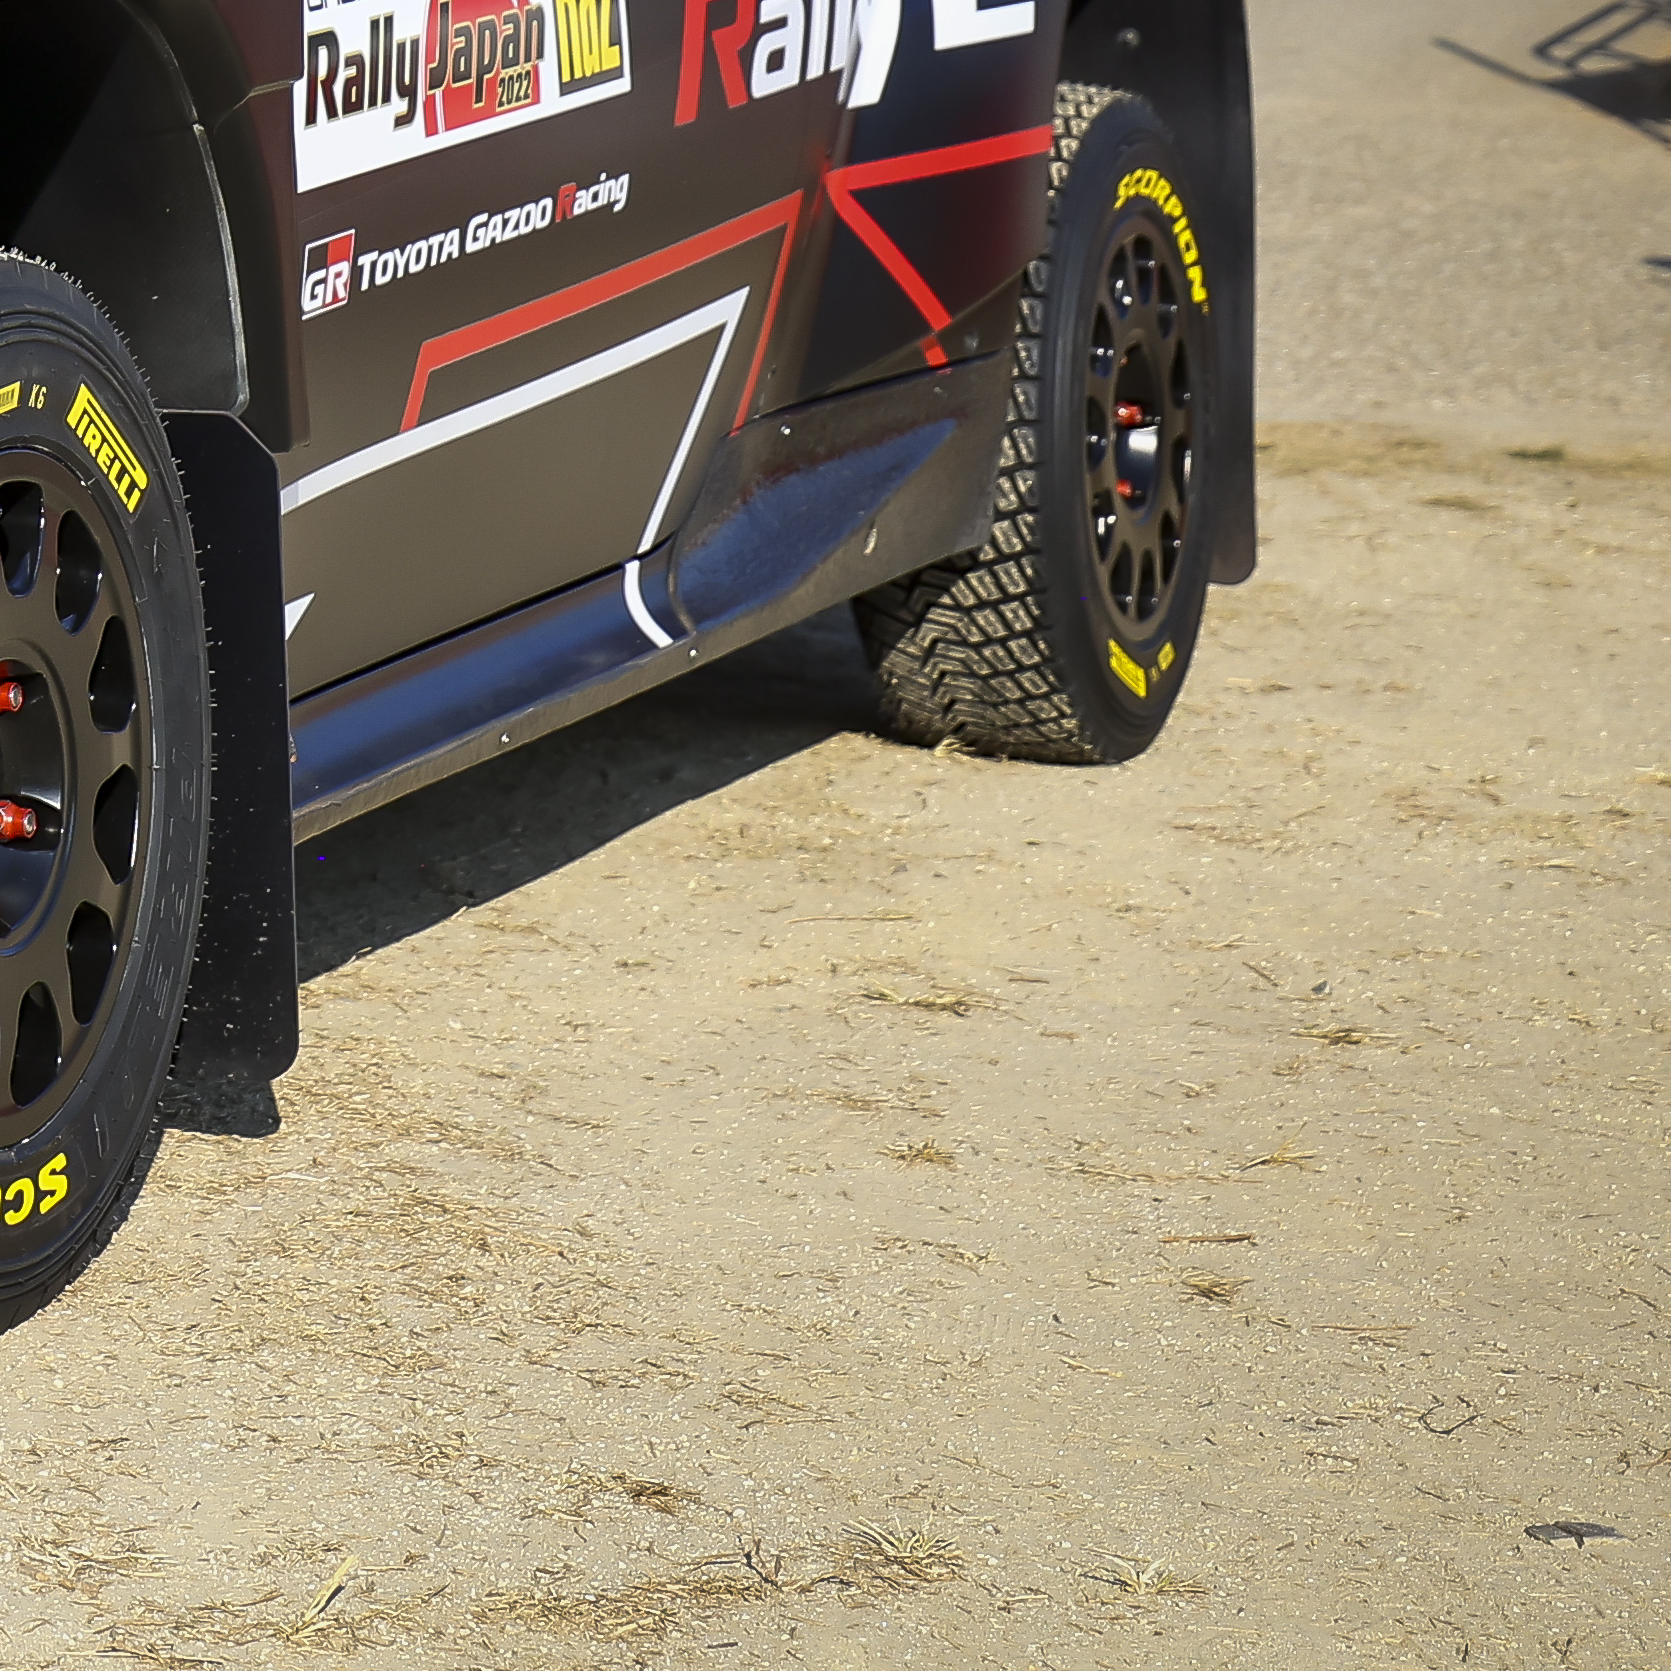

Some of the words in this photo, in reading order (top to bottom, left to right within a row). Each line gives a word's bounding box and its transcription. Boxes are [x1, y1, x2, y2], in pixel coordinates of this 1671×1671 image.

[304, 10, 422, 131] Rally
[495, 68, 533, 113] 2022
[357, 227, 460, 292] TOYOTA
[465, 197, 554, 255] GAZOO
[555, 172, 630, 223] Racing
[1113, 167, 1208, 304] SCORPION
[66, 382, 149, 514] PIRELLI
